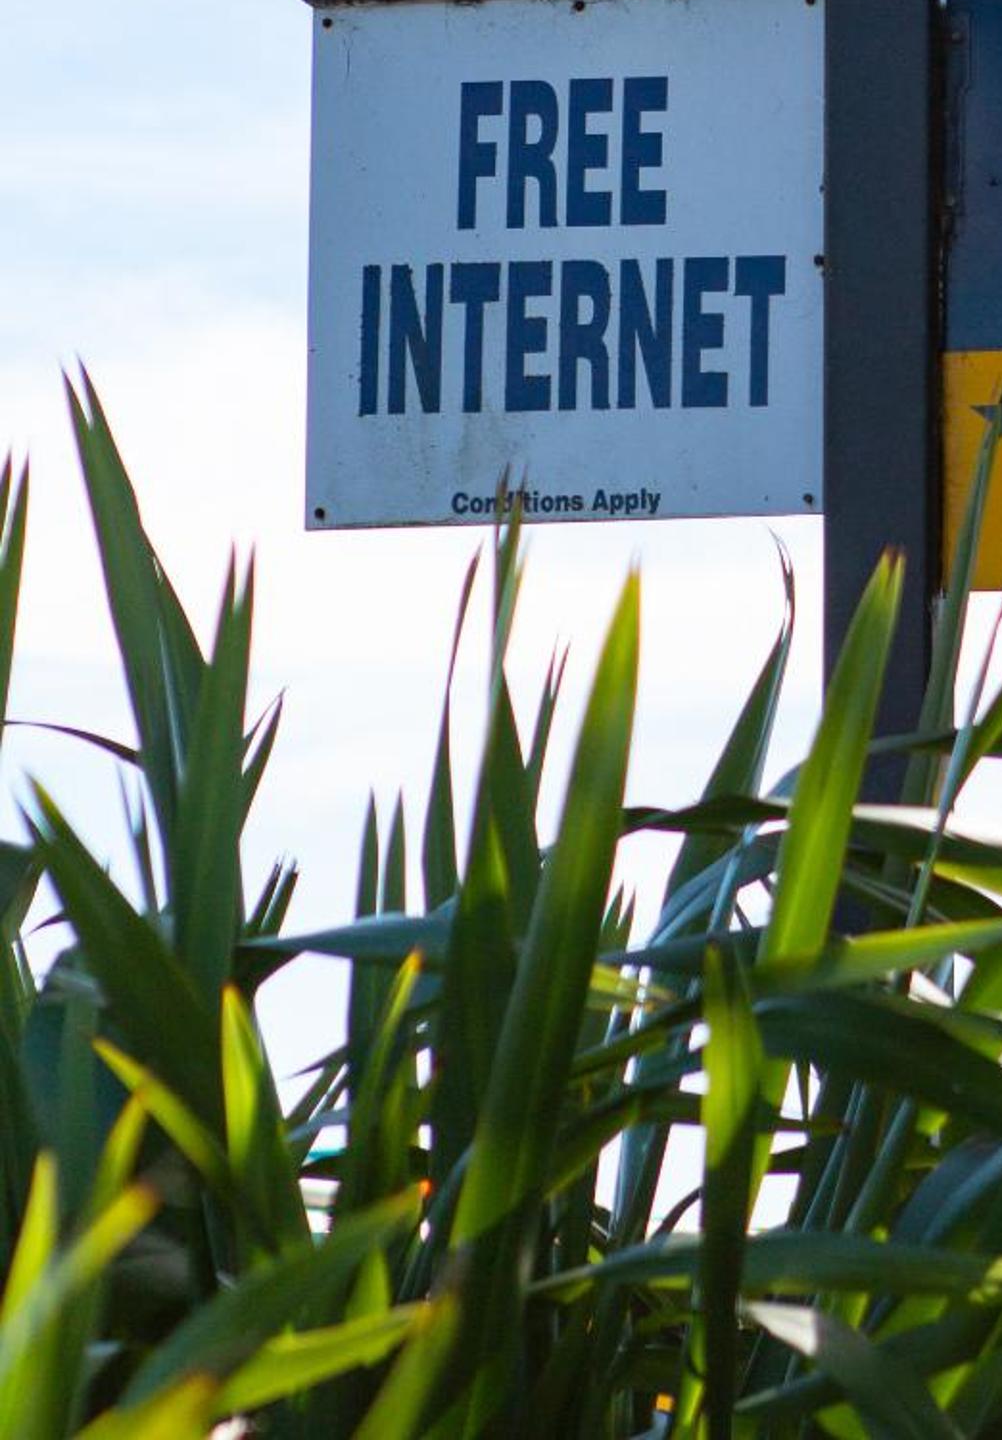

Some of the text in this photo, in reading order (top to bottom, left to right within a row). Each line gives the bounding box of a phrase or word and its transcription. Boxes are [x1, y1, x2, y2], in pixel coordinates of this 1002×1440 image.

[457, 76, 669, 230] FREE
[358, 255, 787, 417] INTERNET
[592, 489, 661, 514] Apply
